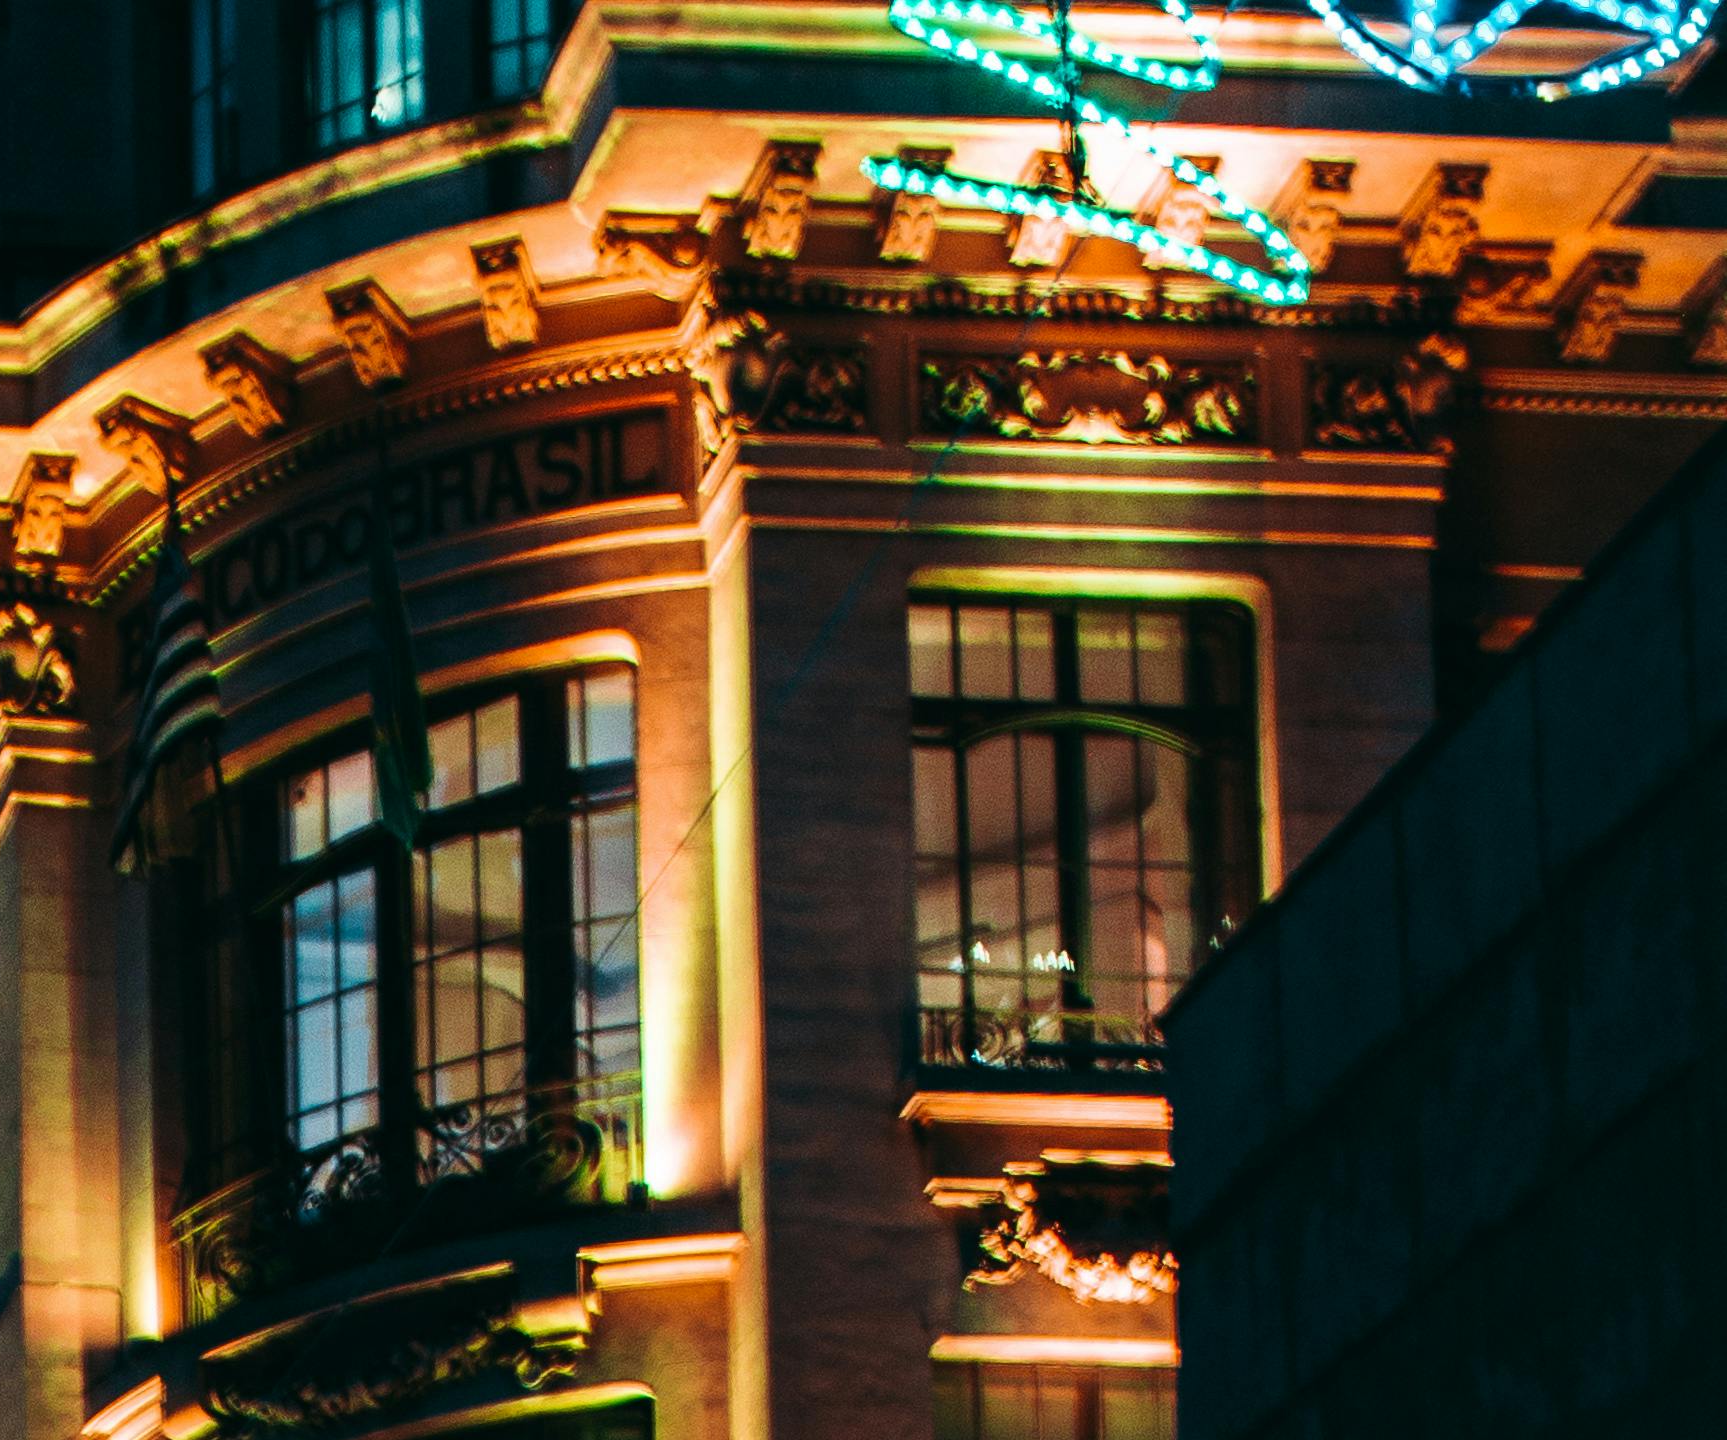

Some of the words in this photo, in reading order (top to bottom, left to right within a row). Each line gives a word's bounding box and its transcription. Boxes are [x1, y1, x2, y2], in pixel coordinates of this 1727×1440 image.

[119, 528, 288, 689] BCO
[294, 507, 370, 583] DO
[389, 422, 657, 547] BRASIL
